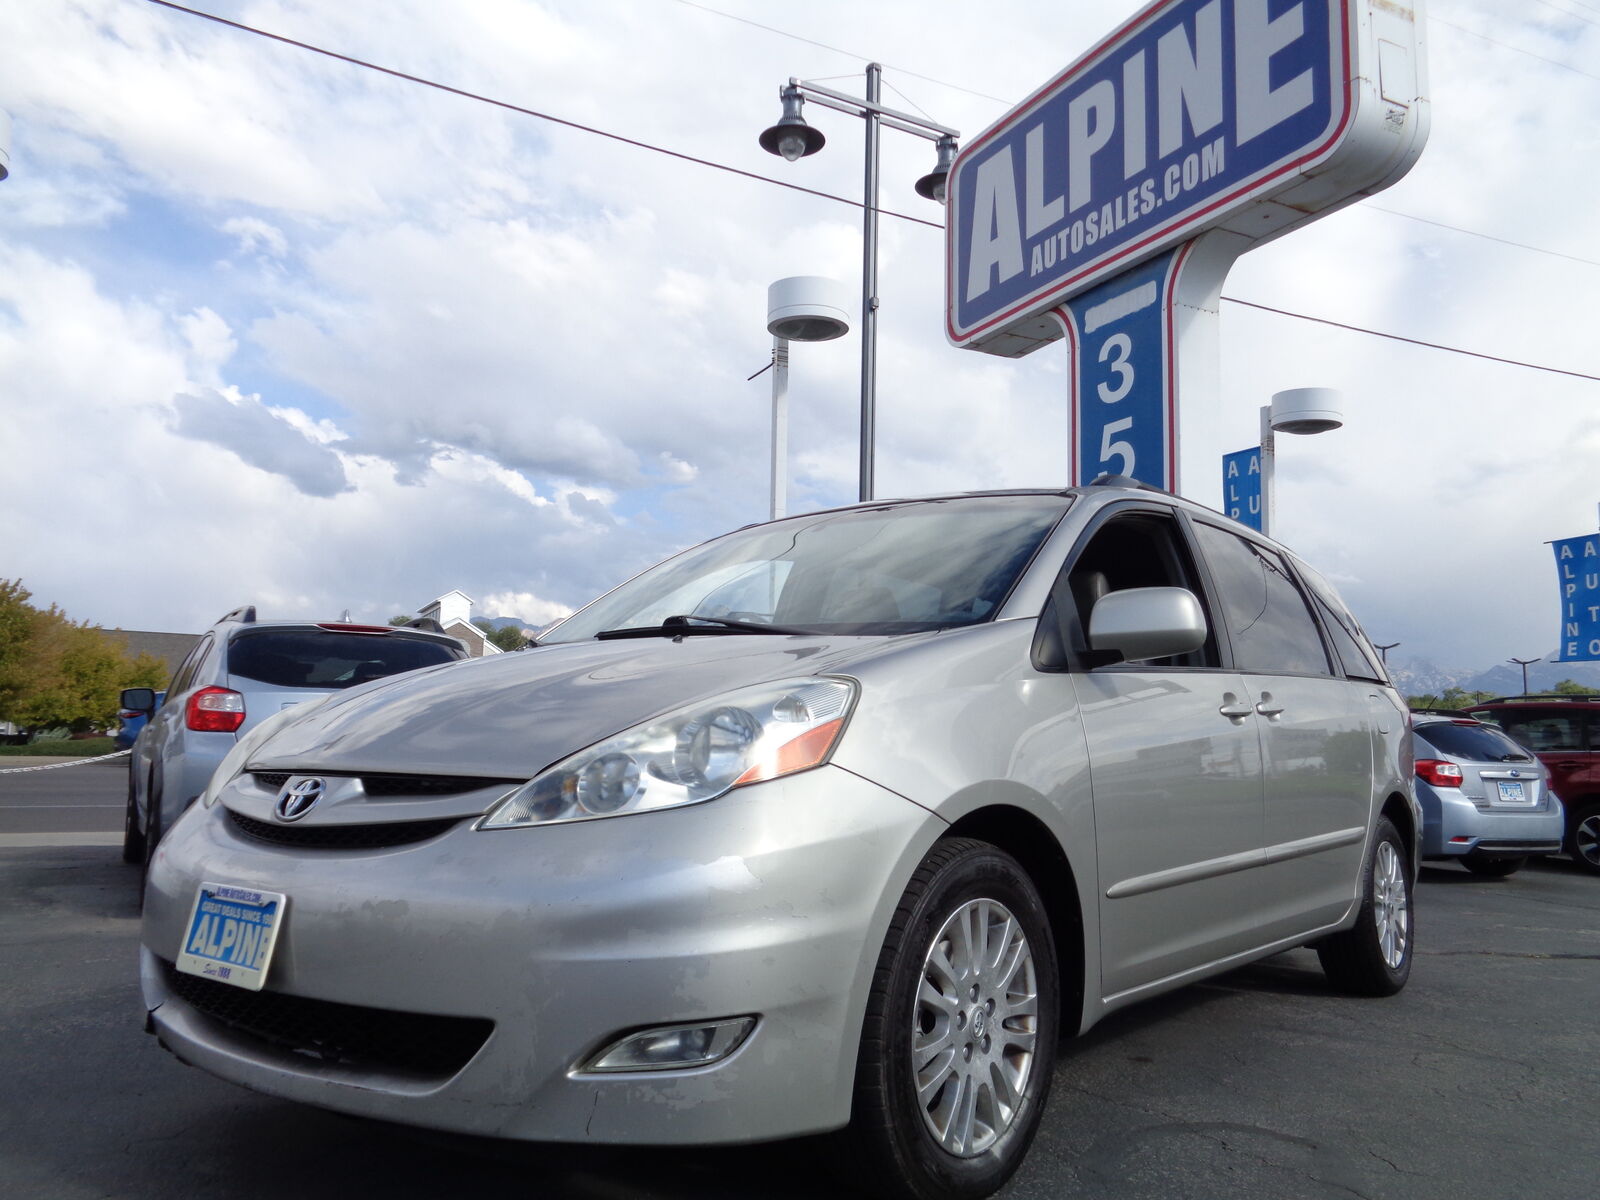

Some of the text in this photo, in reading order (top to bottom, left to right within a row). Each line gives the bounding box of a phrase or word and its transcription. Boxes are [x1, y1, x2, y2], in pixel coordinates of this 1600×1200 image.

[966, 0, 1314, 303] ALPINE
[1030, 136, 1225, 278] AUTOSALES.COM
[1560, 544, 1579, 657] ALPINE
[1583, 540, 1600, 656] AUTO
[189, 913, 272, 969] ALPINE
